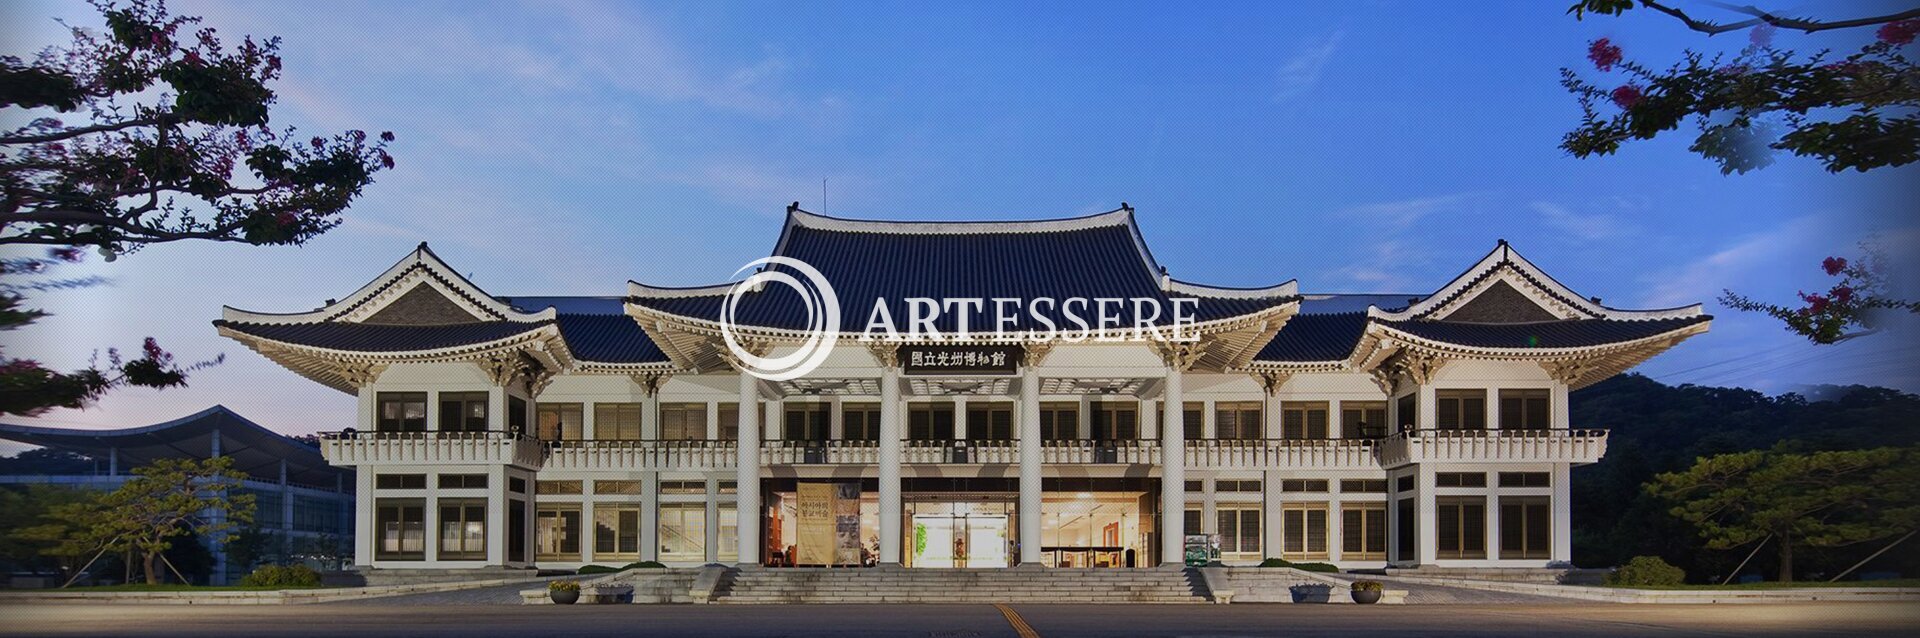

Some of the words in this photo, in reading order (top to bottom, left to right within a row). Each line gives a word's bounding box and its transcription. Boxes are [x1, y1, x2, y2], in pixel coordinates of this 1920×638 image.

[911, 351, 1006, 366] 國立光州博物館
